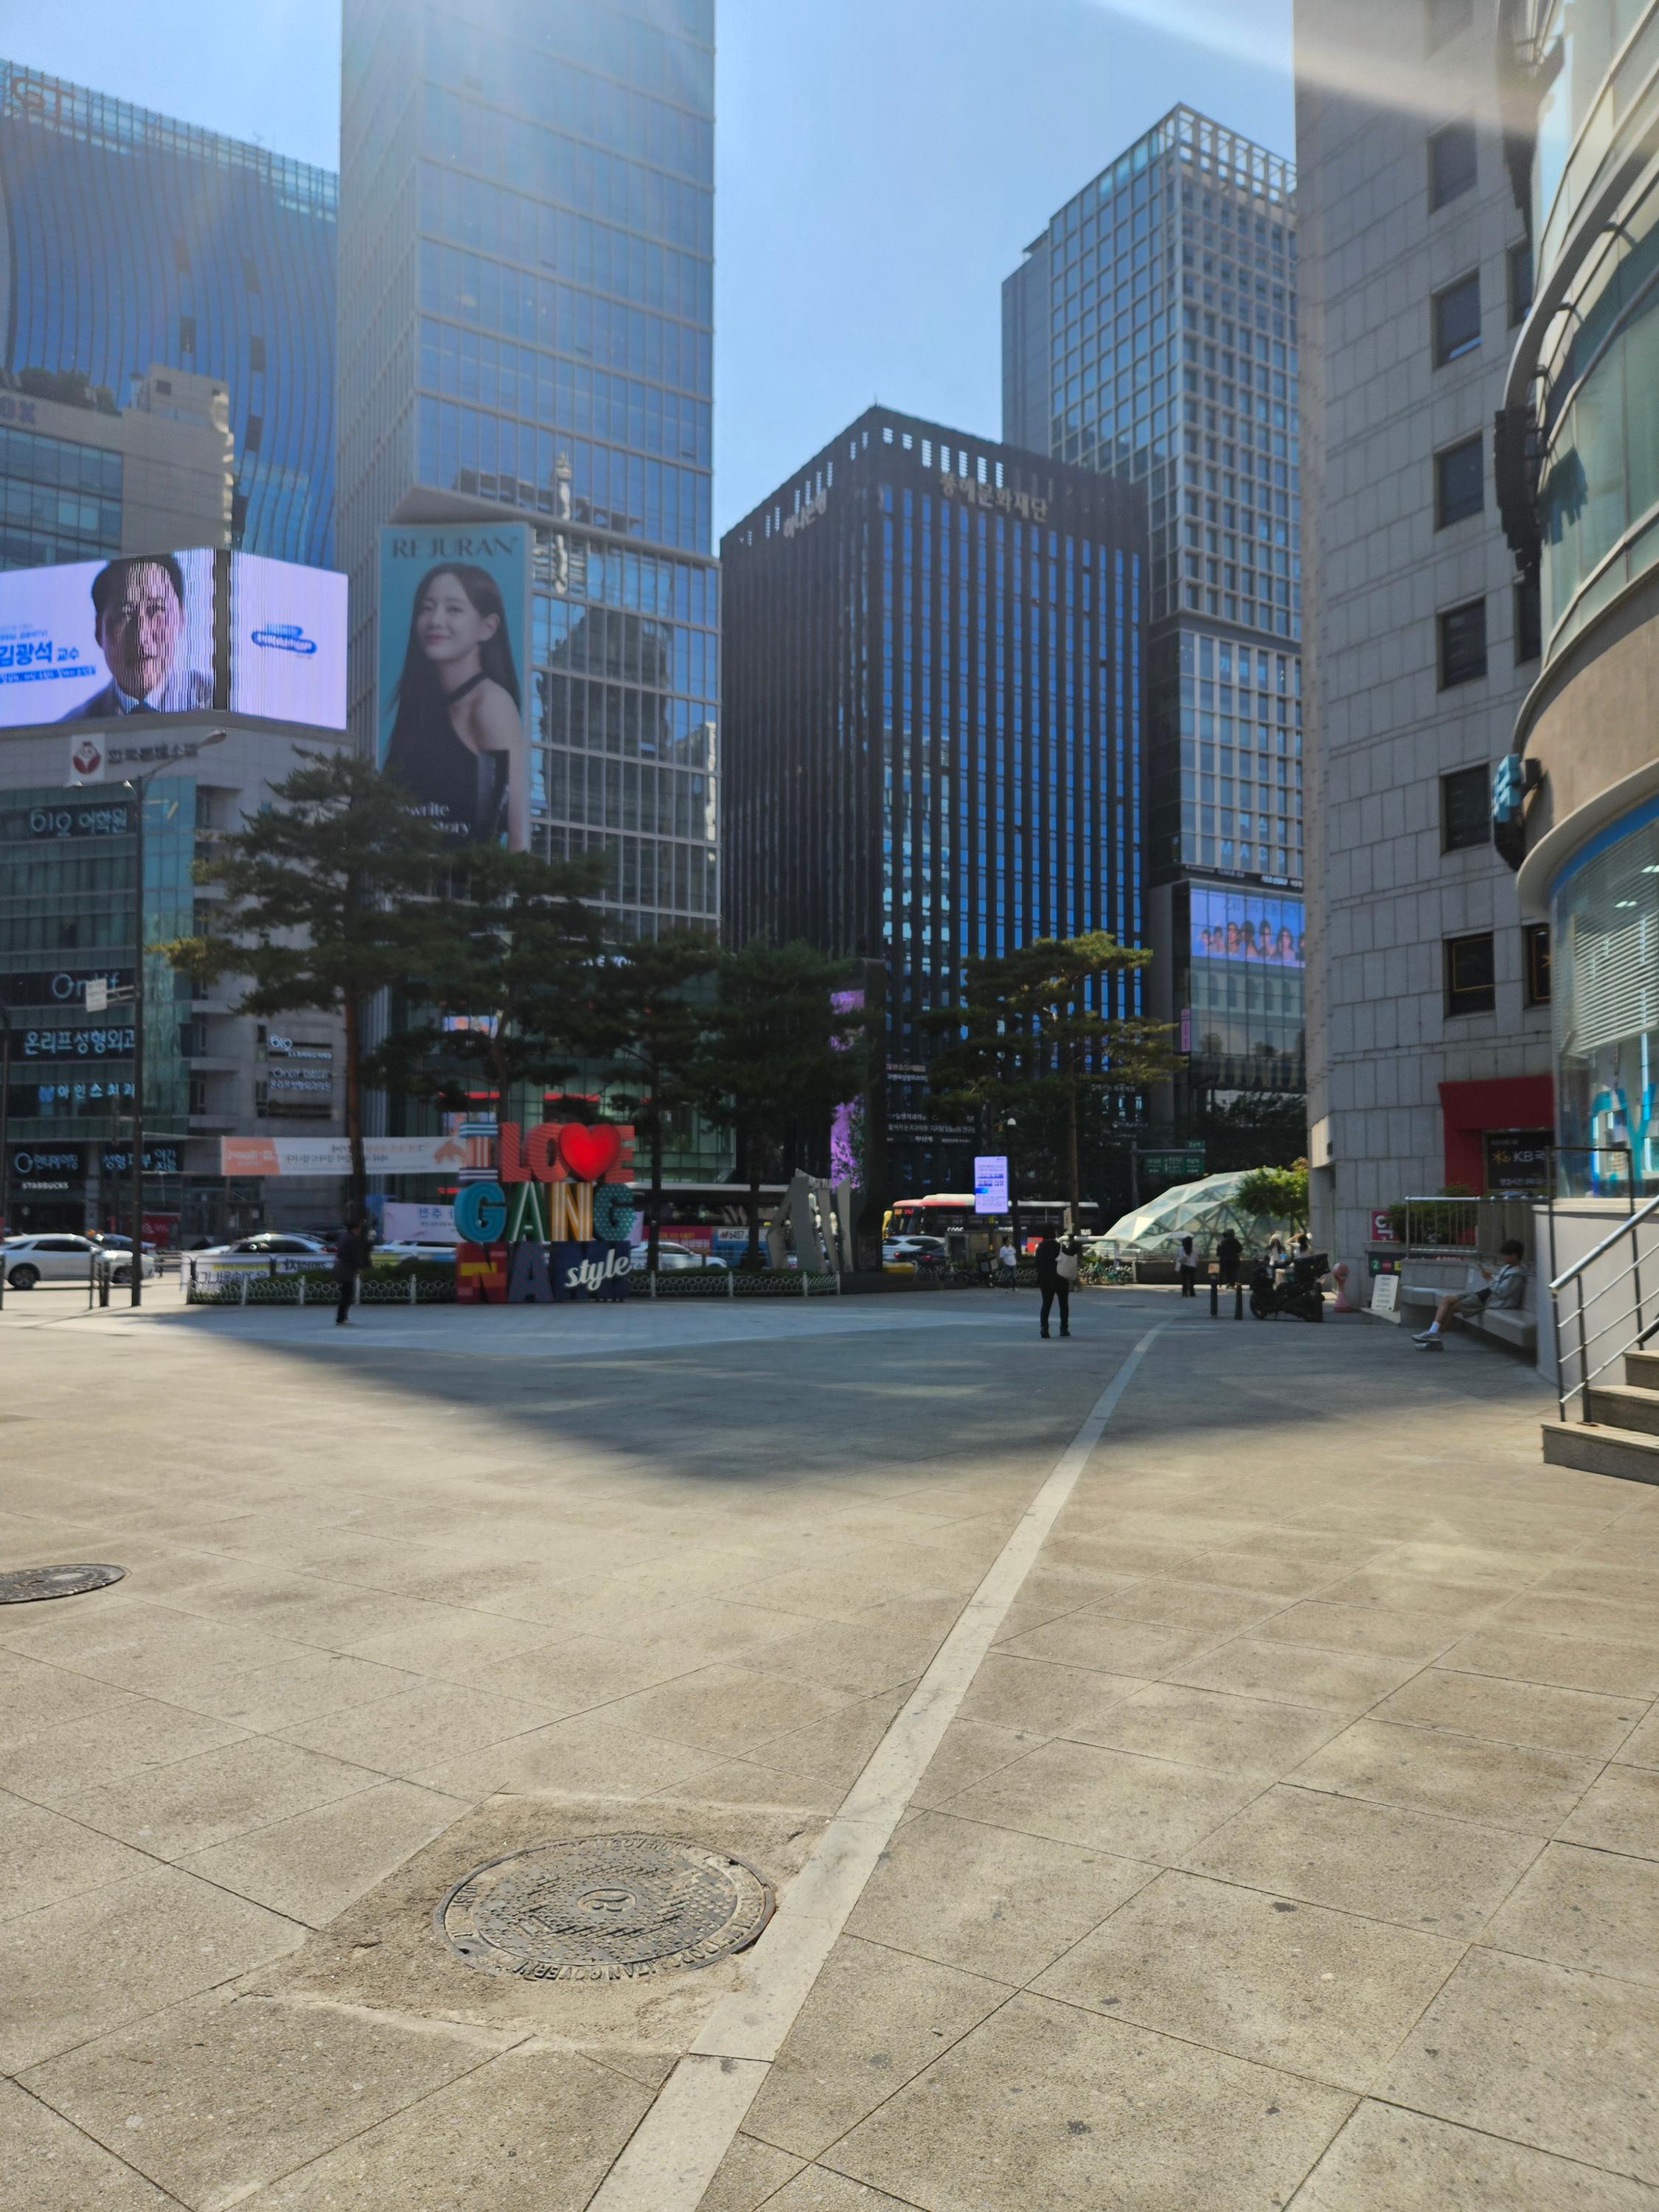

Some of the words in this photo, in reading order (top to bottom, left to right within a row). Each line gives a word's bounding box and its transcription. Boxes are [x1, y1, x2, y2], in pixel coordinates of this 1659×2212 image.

[58, 647, 80, 661] 교수
[22, 1181, 69, 1189] STARBUCKS
[454, 1180, 636, 1242] GANG
[564, 1248, 633, 1291] style
